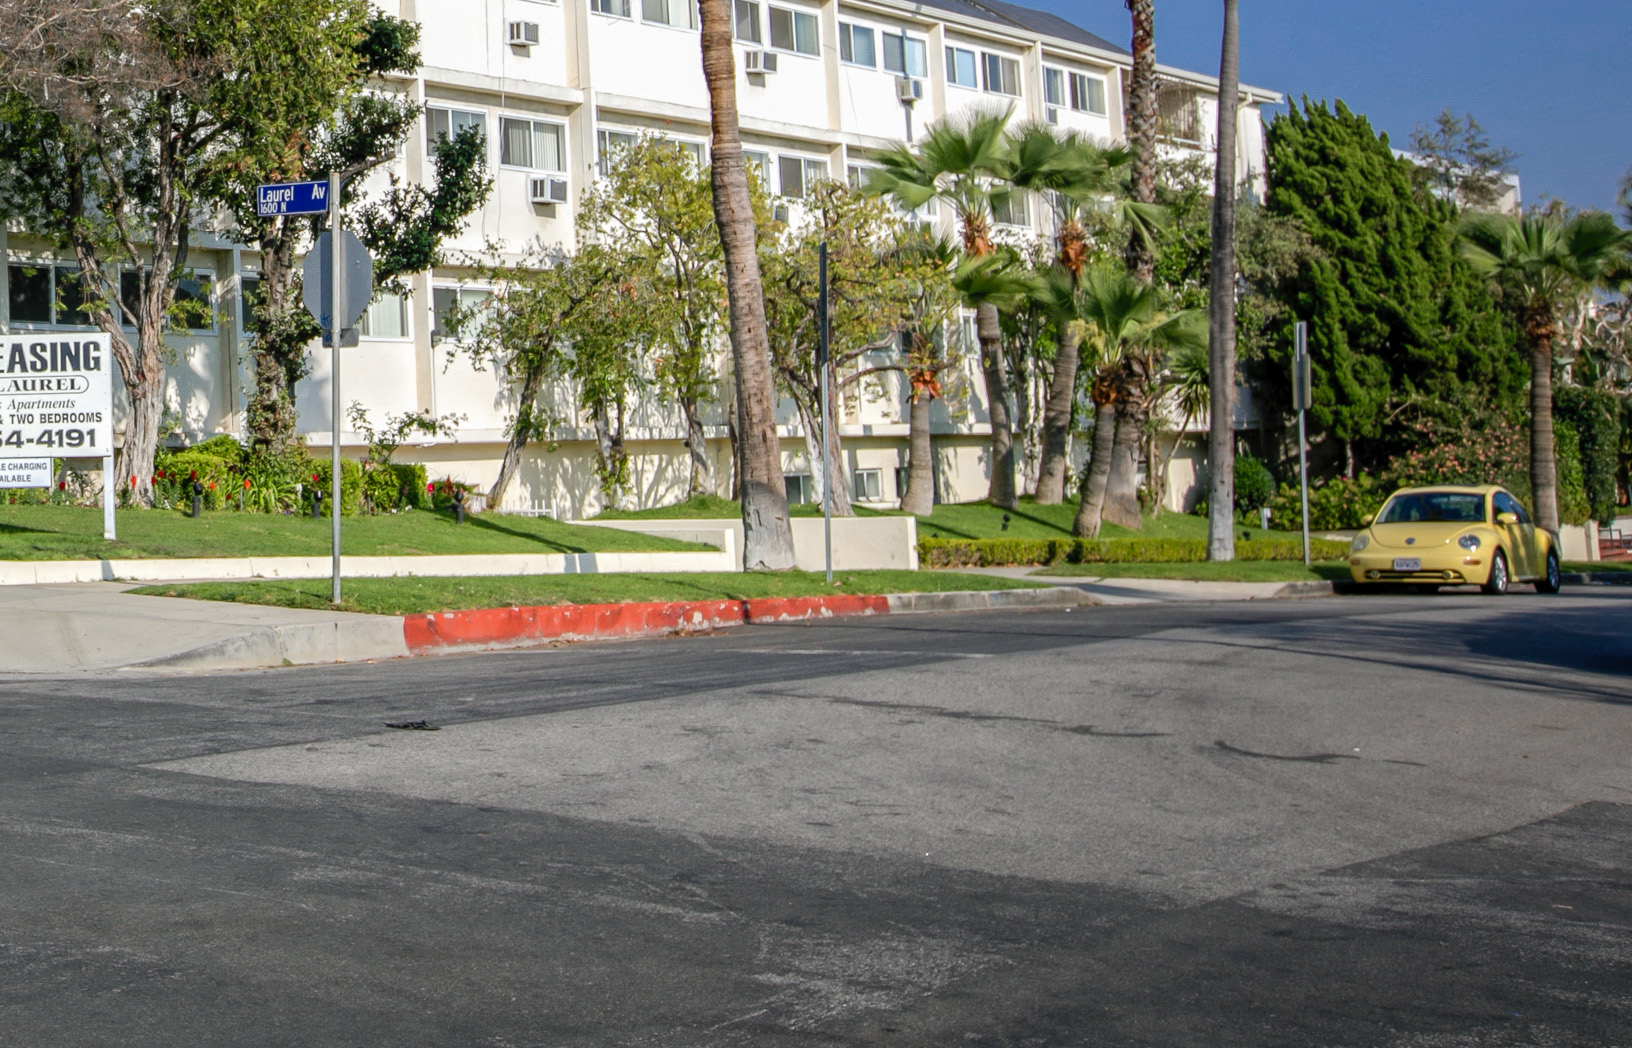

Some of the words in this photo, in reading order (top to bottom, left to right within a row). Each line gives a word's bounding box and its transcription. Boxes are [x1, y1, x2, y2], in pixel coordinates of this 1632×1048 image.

[260, 186, 294, 203] Laurel
[311, 183, 326, 200] Av
[260, 202, 278, 214] 1600
[280, 202, 287, 212] N
[7, 397, 76, 412] Apartments
[9, 413, 35, 425] TWO
[39, 412, 103, 424] BEDROOMS
[7, 462, 48, 471] CHARGING
